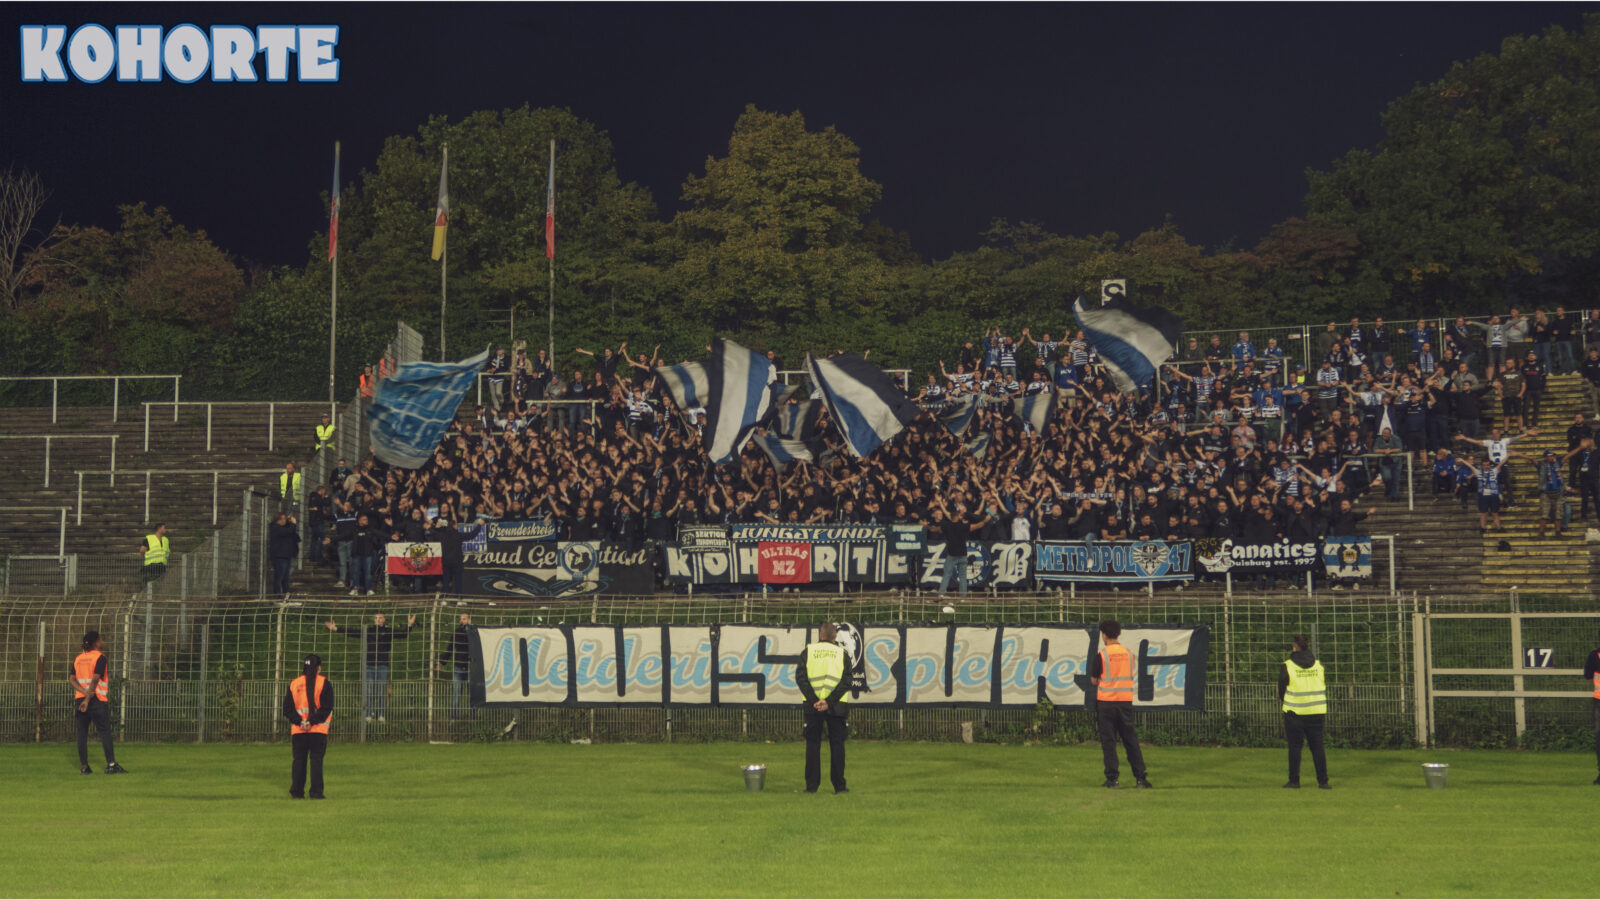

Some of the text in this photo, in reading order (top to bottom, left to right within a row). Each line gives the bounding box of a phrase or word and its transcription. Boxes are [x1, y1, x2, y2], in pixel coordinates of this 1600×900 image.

[488, 521, 555, 538] Freundeskreis
[667, 545, 908, 577] KOHRTE
[761, 545, 809, 560] ULTRAS
[1167, 542, 1191, 572] 47
[1294, 557, 1316, 566] 1997
[772, 560, 796, 576] MZ
[483, 632, 799, 687] Meideriche
[1527, 648, 1553, 668] 17
